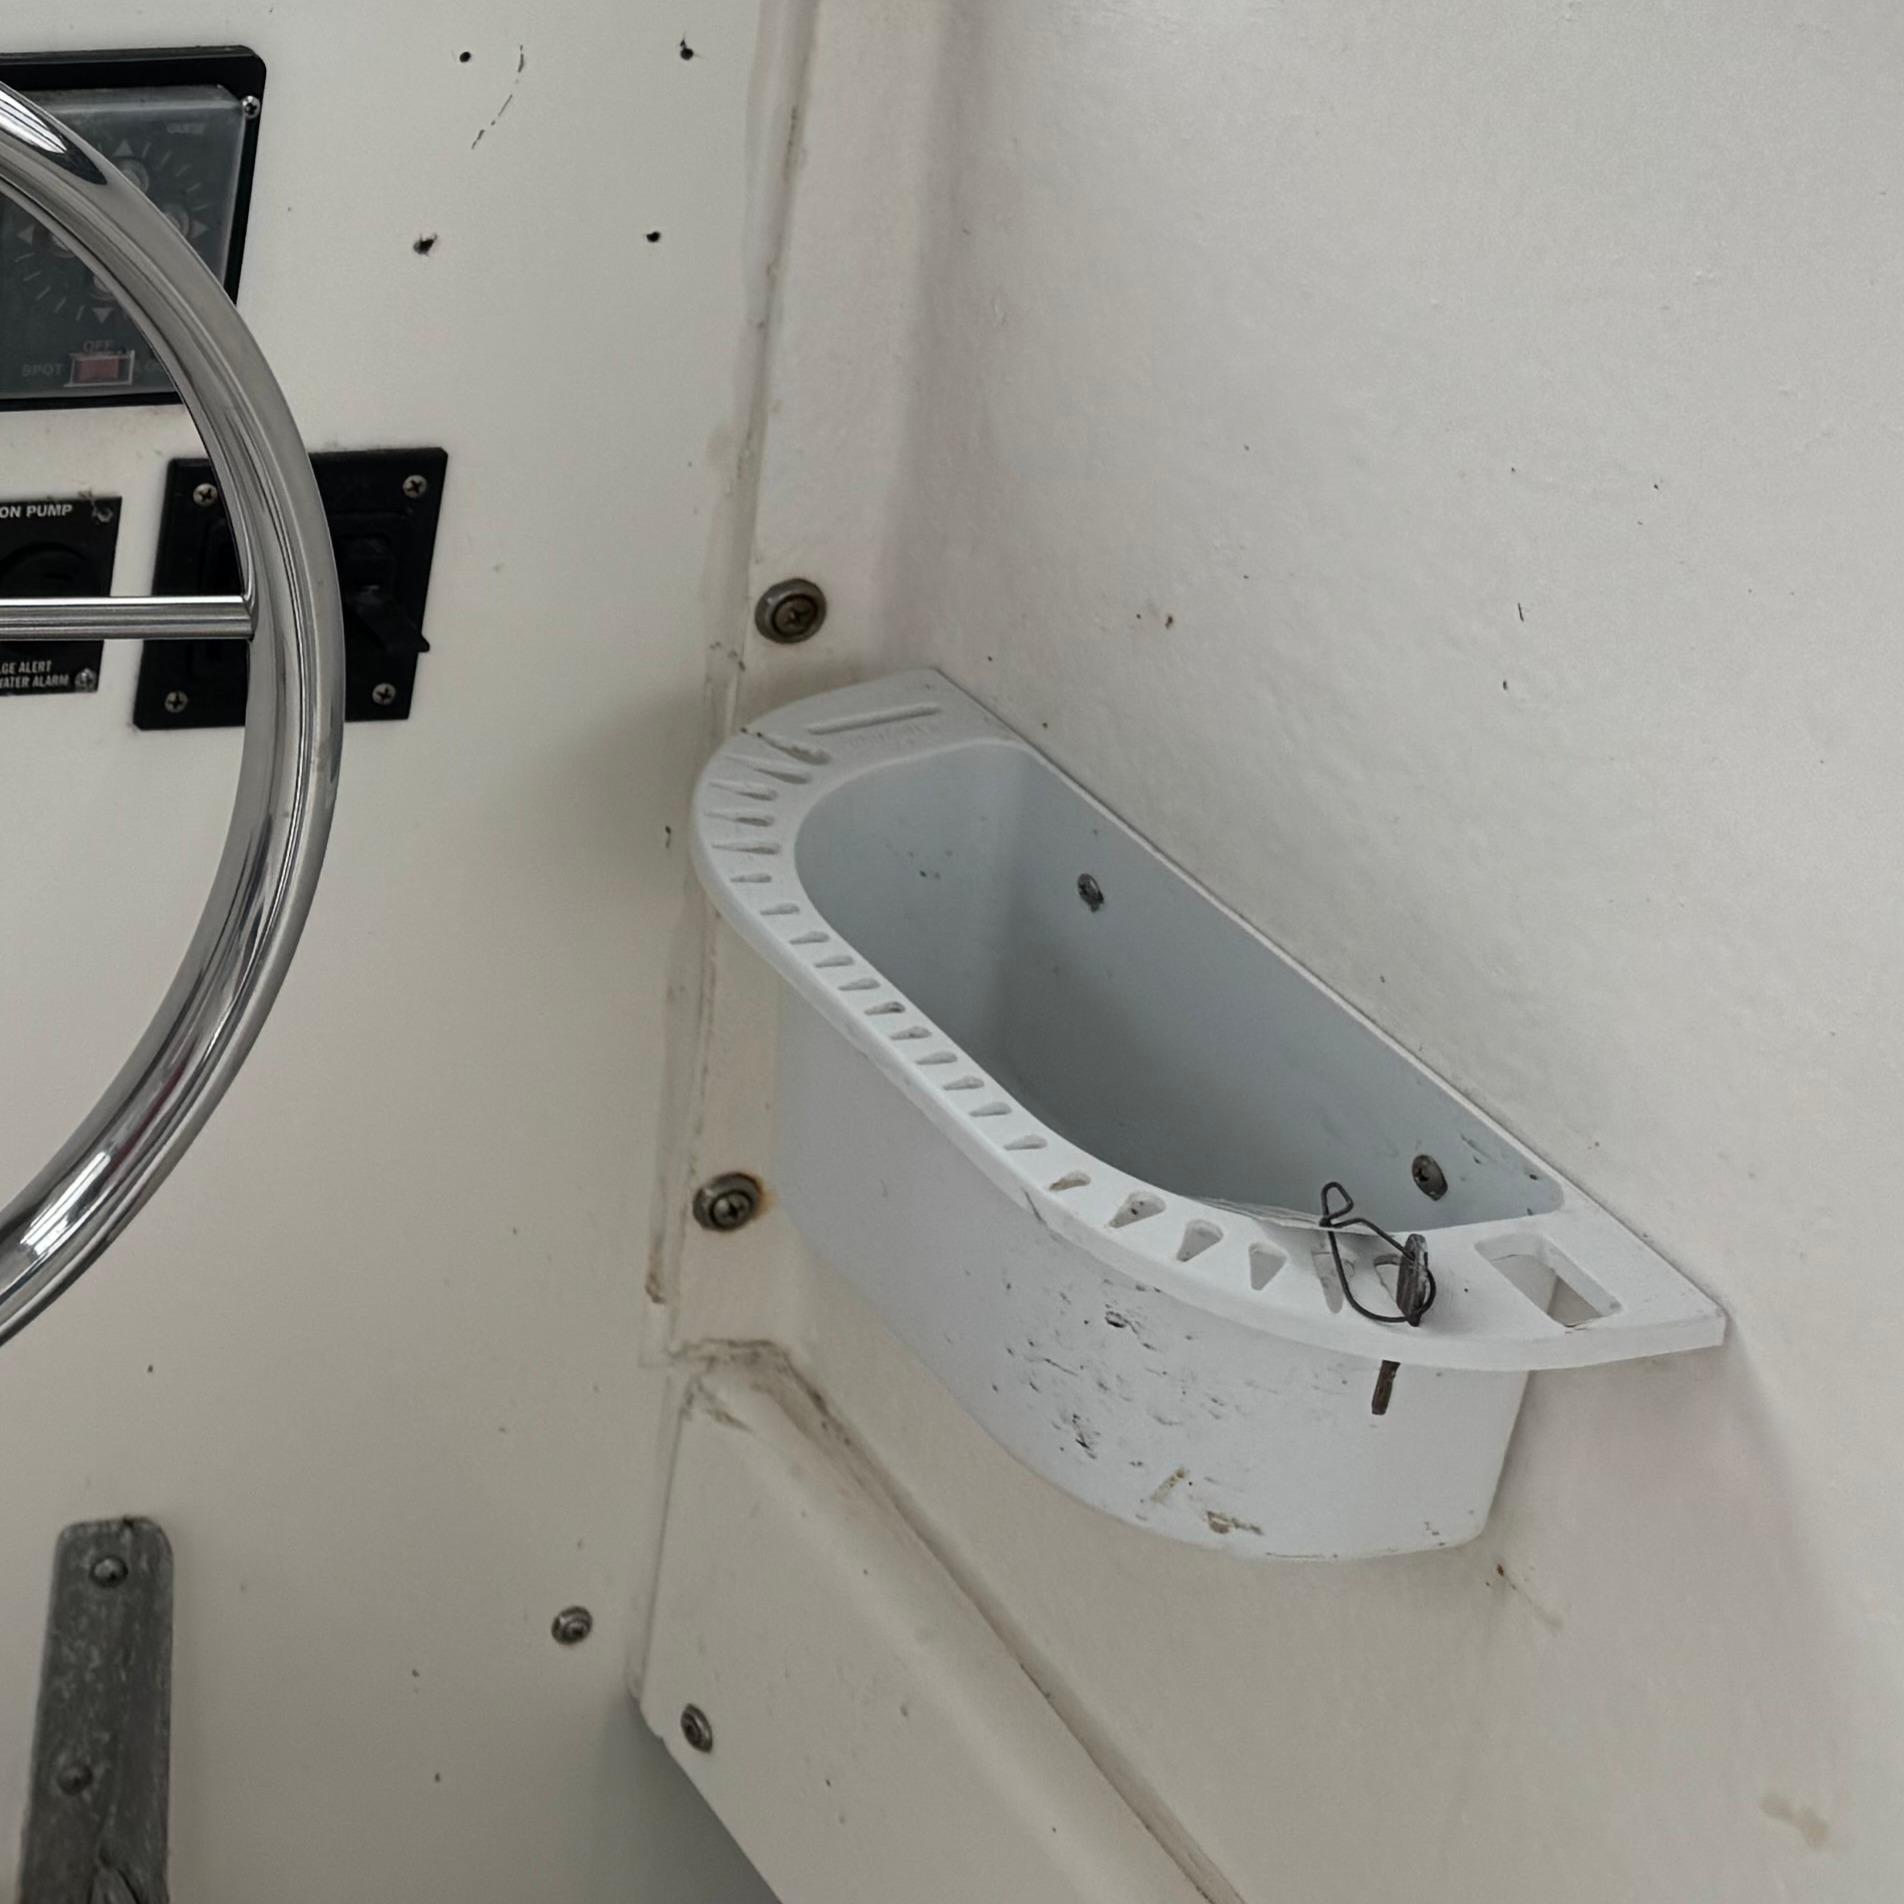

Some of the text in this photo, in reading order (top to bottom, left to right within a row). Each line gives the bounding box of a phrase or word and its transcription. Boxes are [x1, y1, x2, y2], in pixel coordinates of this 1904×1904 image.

[26, 504, 73, 518] PUMP
[18, 660, 52, 674] ALERT
[31, 673, 70, 688] ALARM
